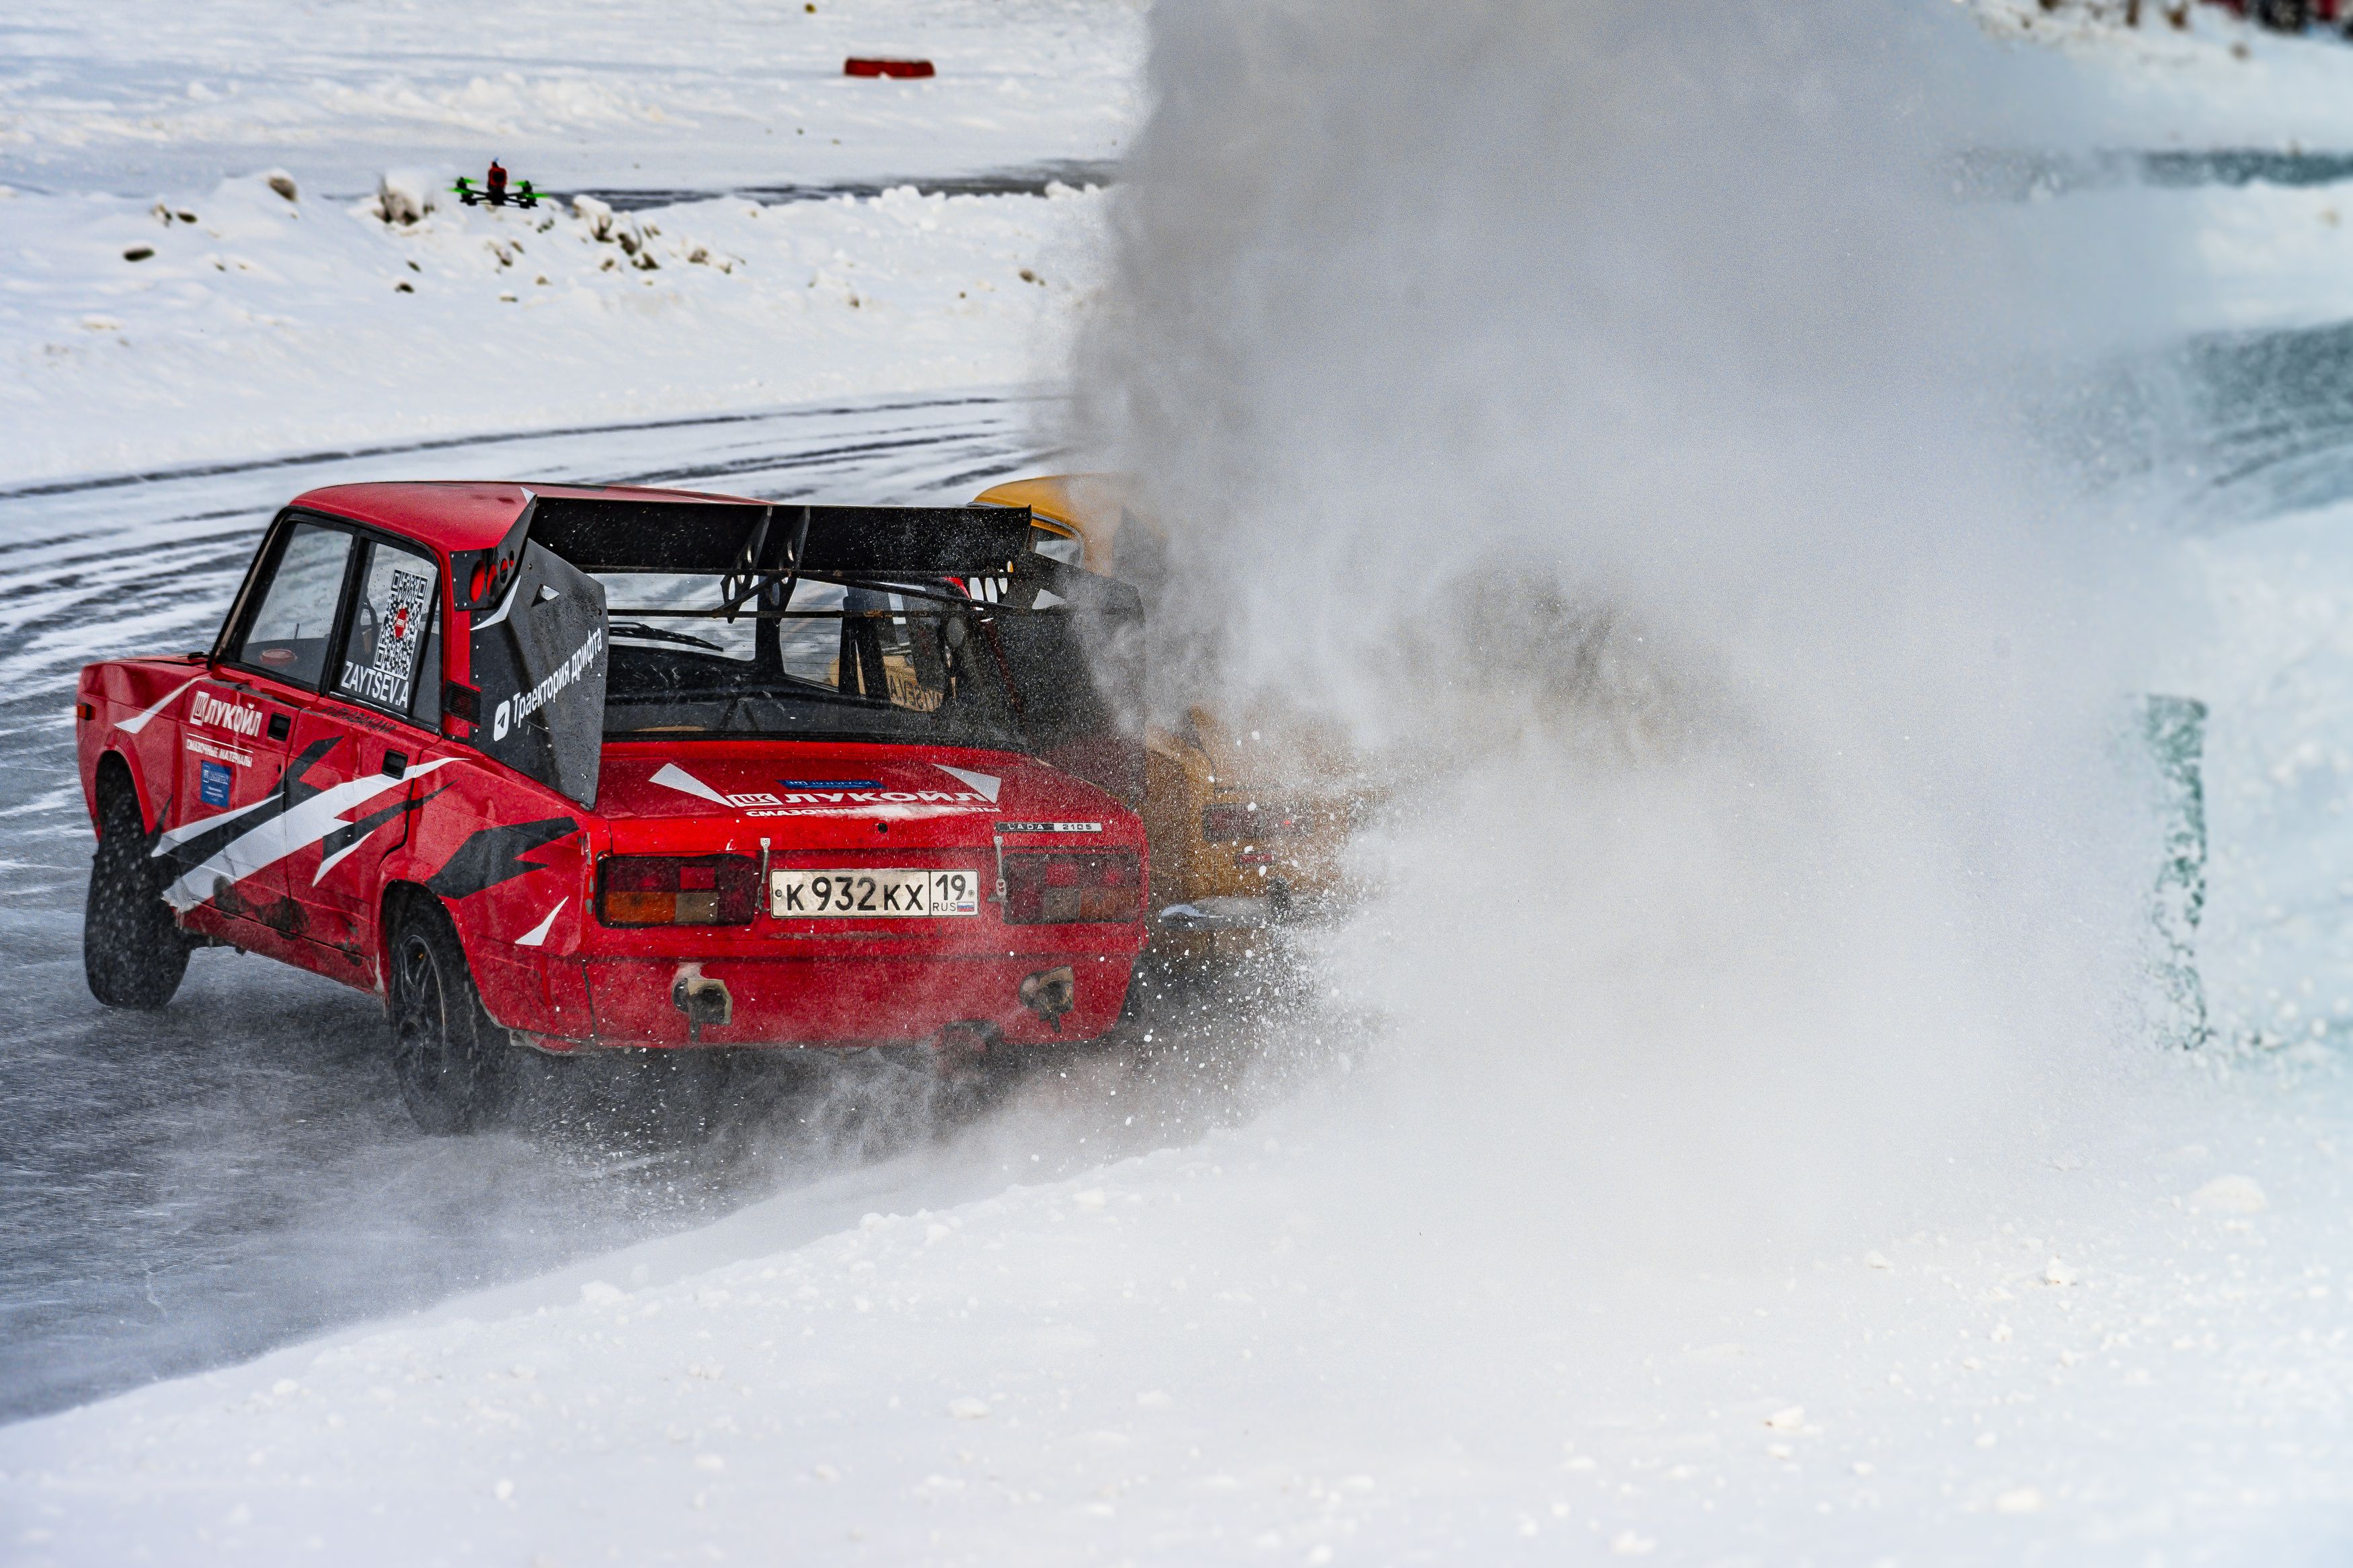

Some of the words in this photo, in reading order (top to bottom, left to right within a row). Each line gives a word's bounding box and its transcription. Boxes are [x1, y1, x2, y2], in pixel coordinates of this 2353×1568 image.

[341, 661, 409, 708] ZAYTSEV.A
[513, 660, 570, 728] Траектория
[571, 628, 602, 684] дрифта
[204, 699, 263, 737] ЛУКОЙЛ
[785, 790, 988, 802] ЛУКОЙЛ
[786, 876, 924, 911] К932КХ
[935, 874, 965, 901] 19
[932, 902, 955, 912] RUS
